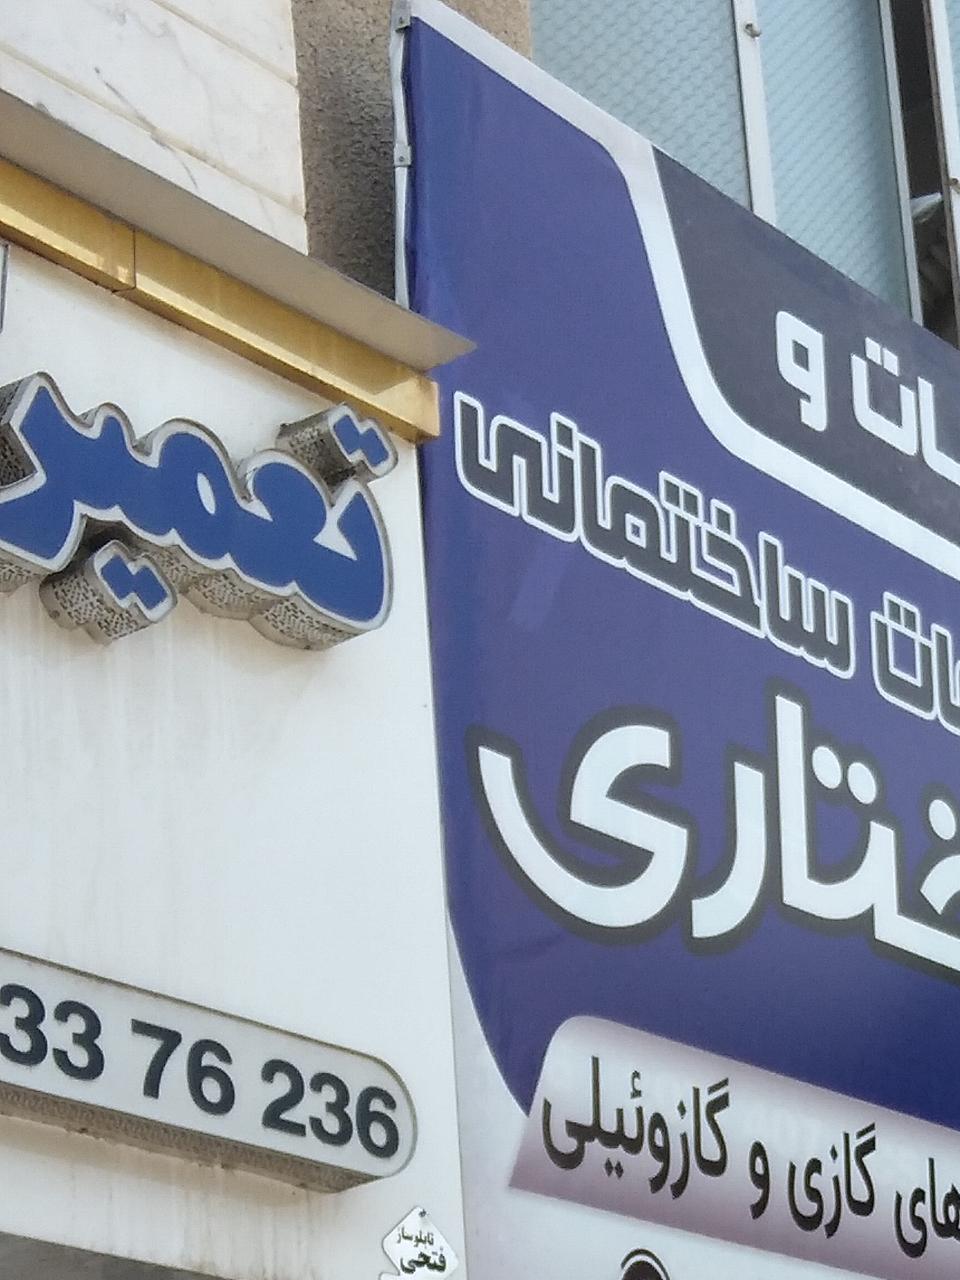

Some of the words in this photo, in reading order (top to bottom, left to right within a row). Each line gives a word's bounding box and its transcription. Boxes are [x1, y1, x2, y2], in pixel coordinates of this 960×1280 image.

[775, 311, 829, 433] و
[454, 391, 855, 680] ساختمانی
[131, 1018, 236, 1116] 76
[261, 1058, 400, 1159] 236
[542, 1056, 731, 1201] گازوئیلی
[749, 1140, 771, 1218] و
[787, 1122, 878, 1239] گازی
